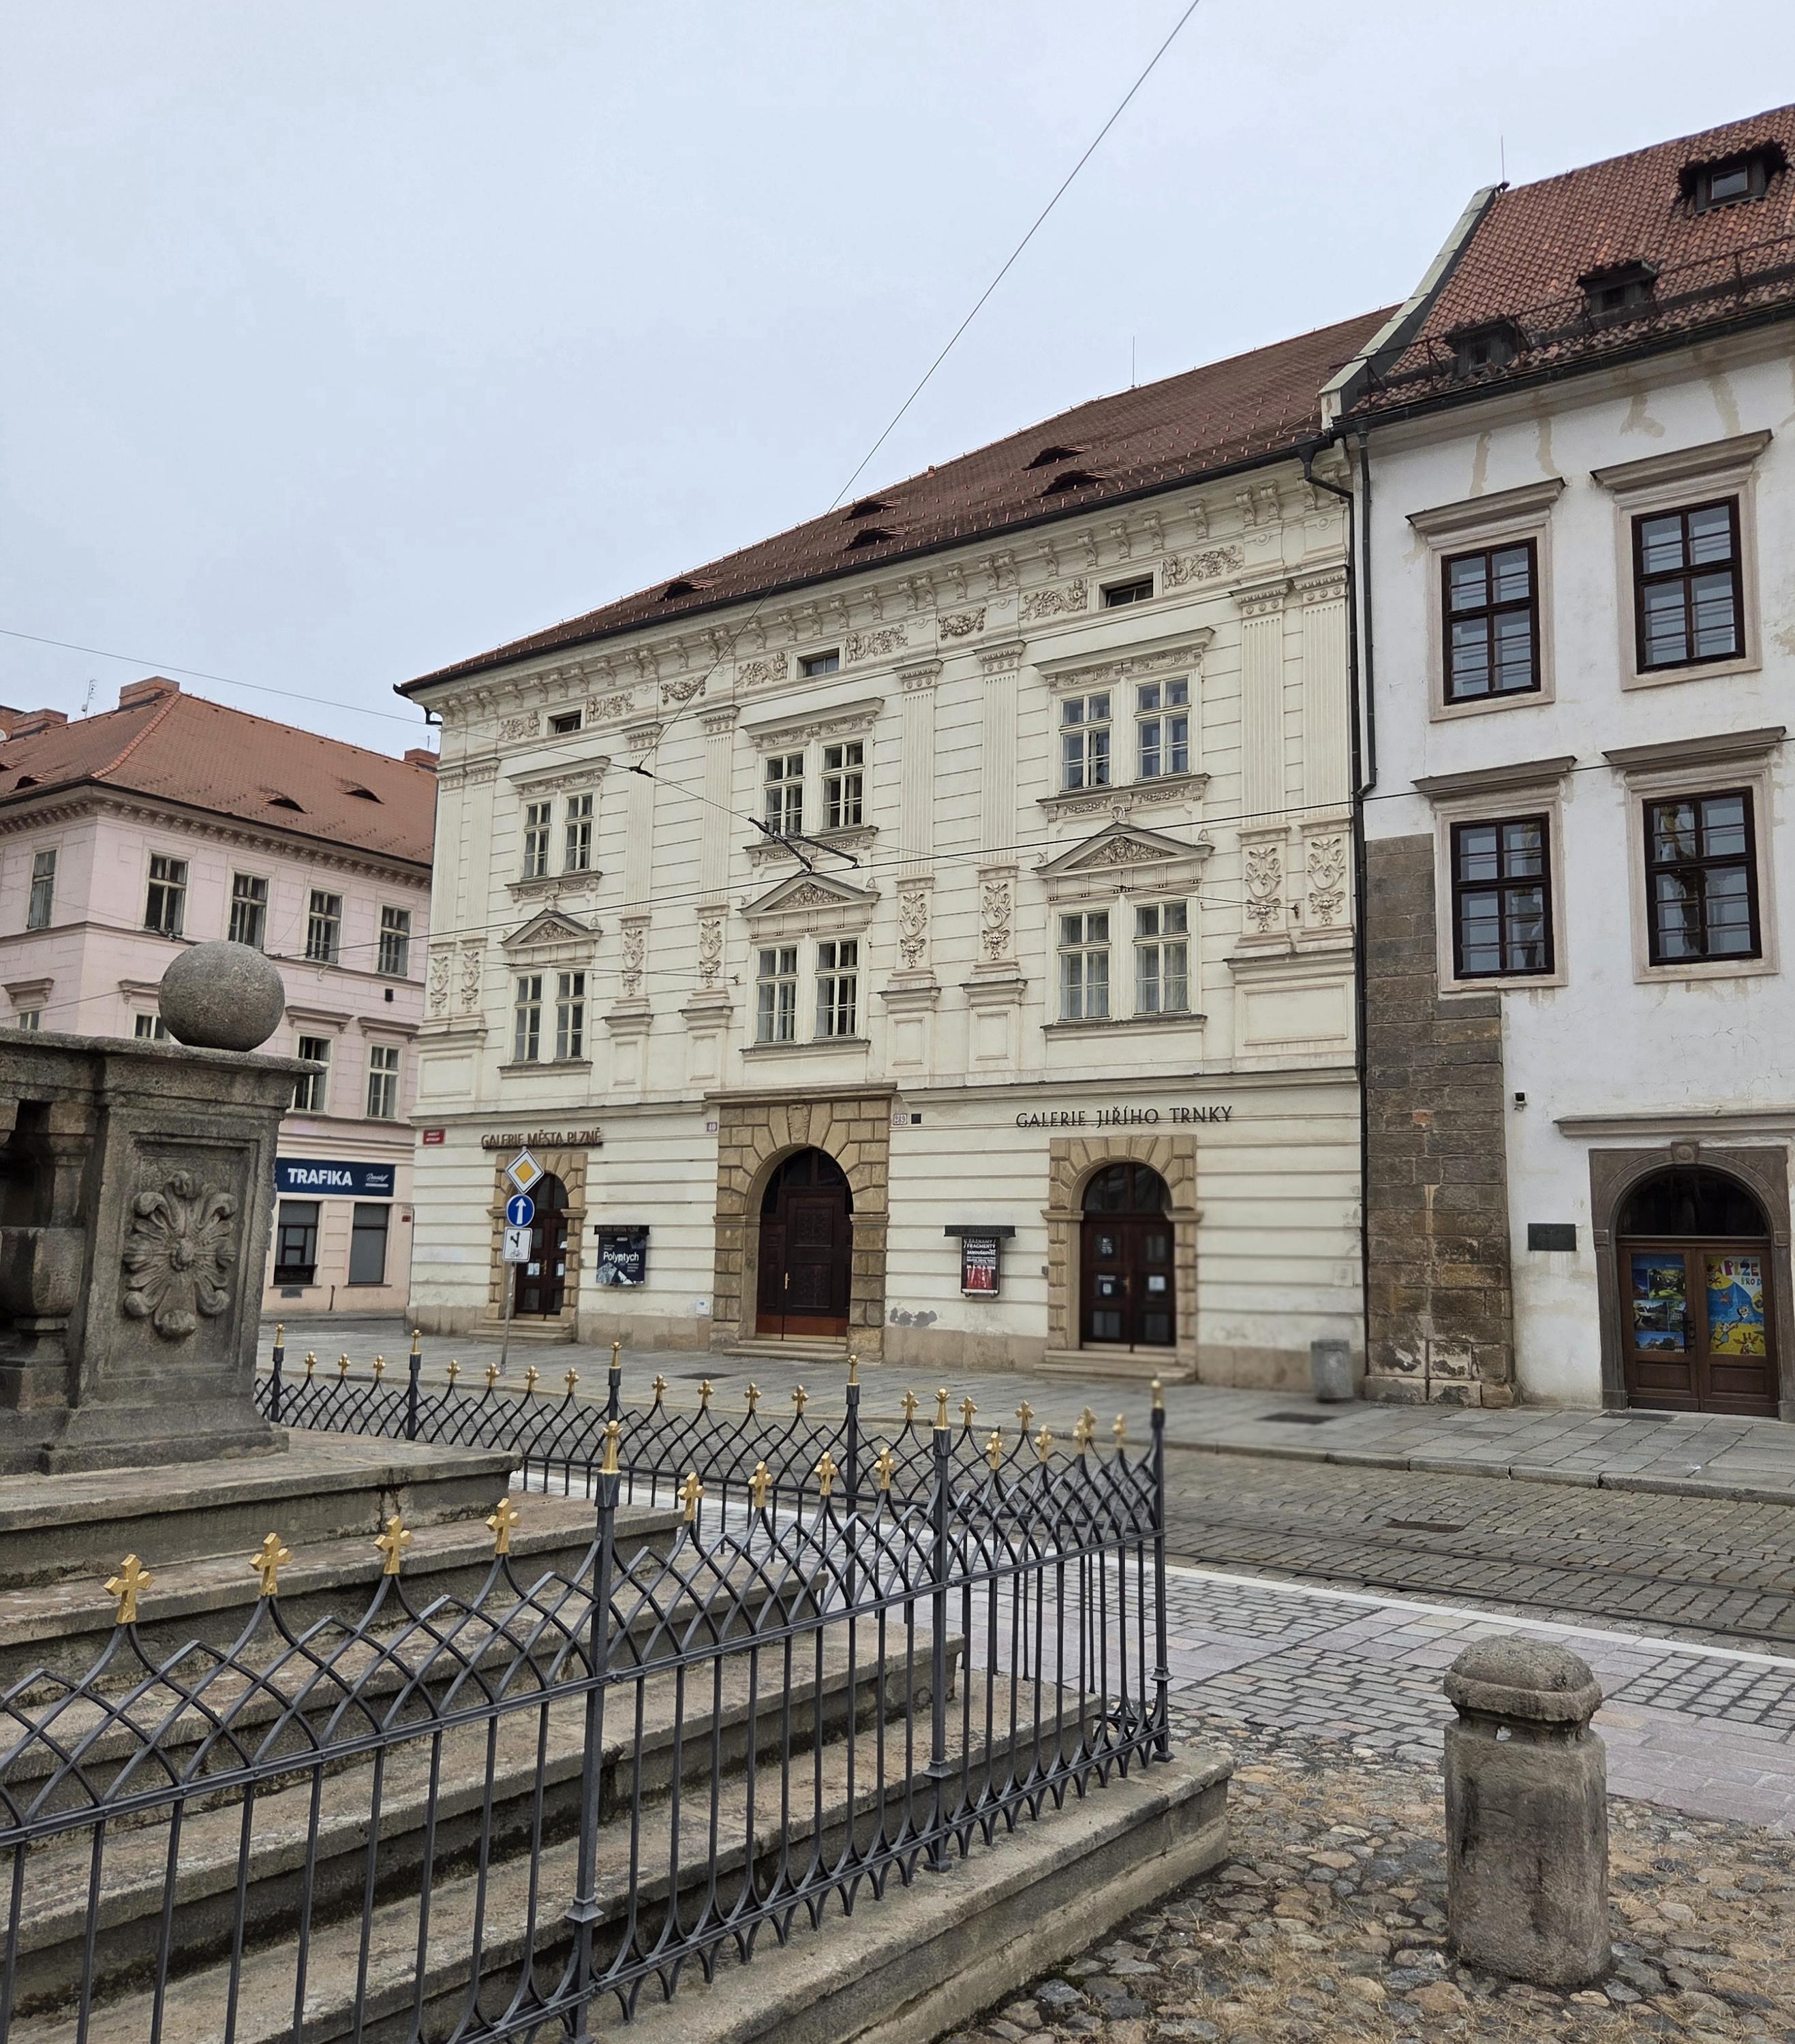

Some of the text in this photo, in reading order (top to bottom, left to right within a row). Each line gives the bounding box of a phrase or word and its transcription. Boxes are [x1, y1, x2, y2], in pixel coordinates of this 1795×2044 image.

[1015, 1105, 1233, 1128] GALERIE JIŘÍHO TRNKY
[481, 1127, 601, 1146] GALERIE MĚSTA PLZNĚ
[288, 1167, 353, 1186] TRAFIKA
[603, 1251, 639, 1263] Polyptych
